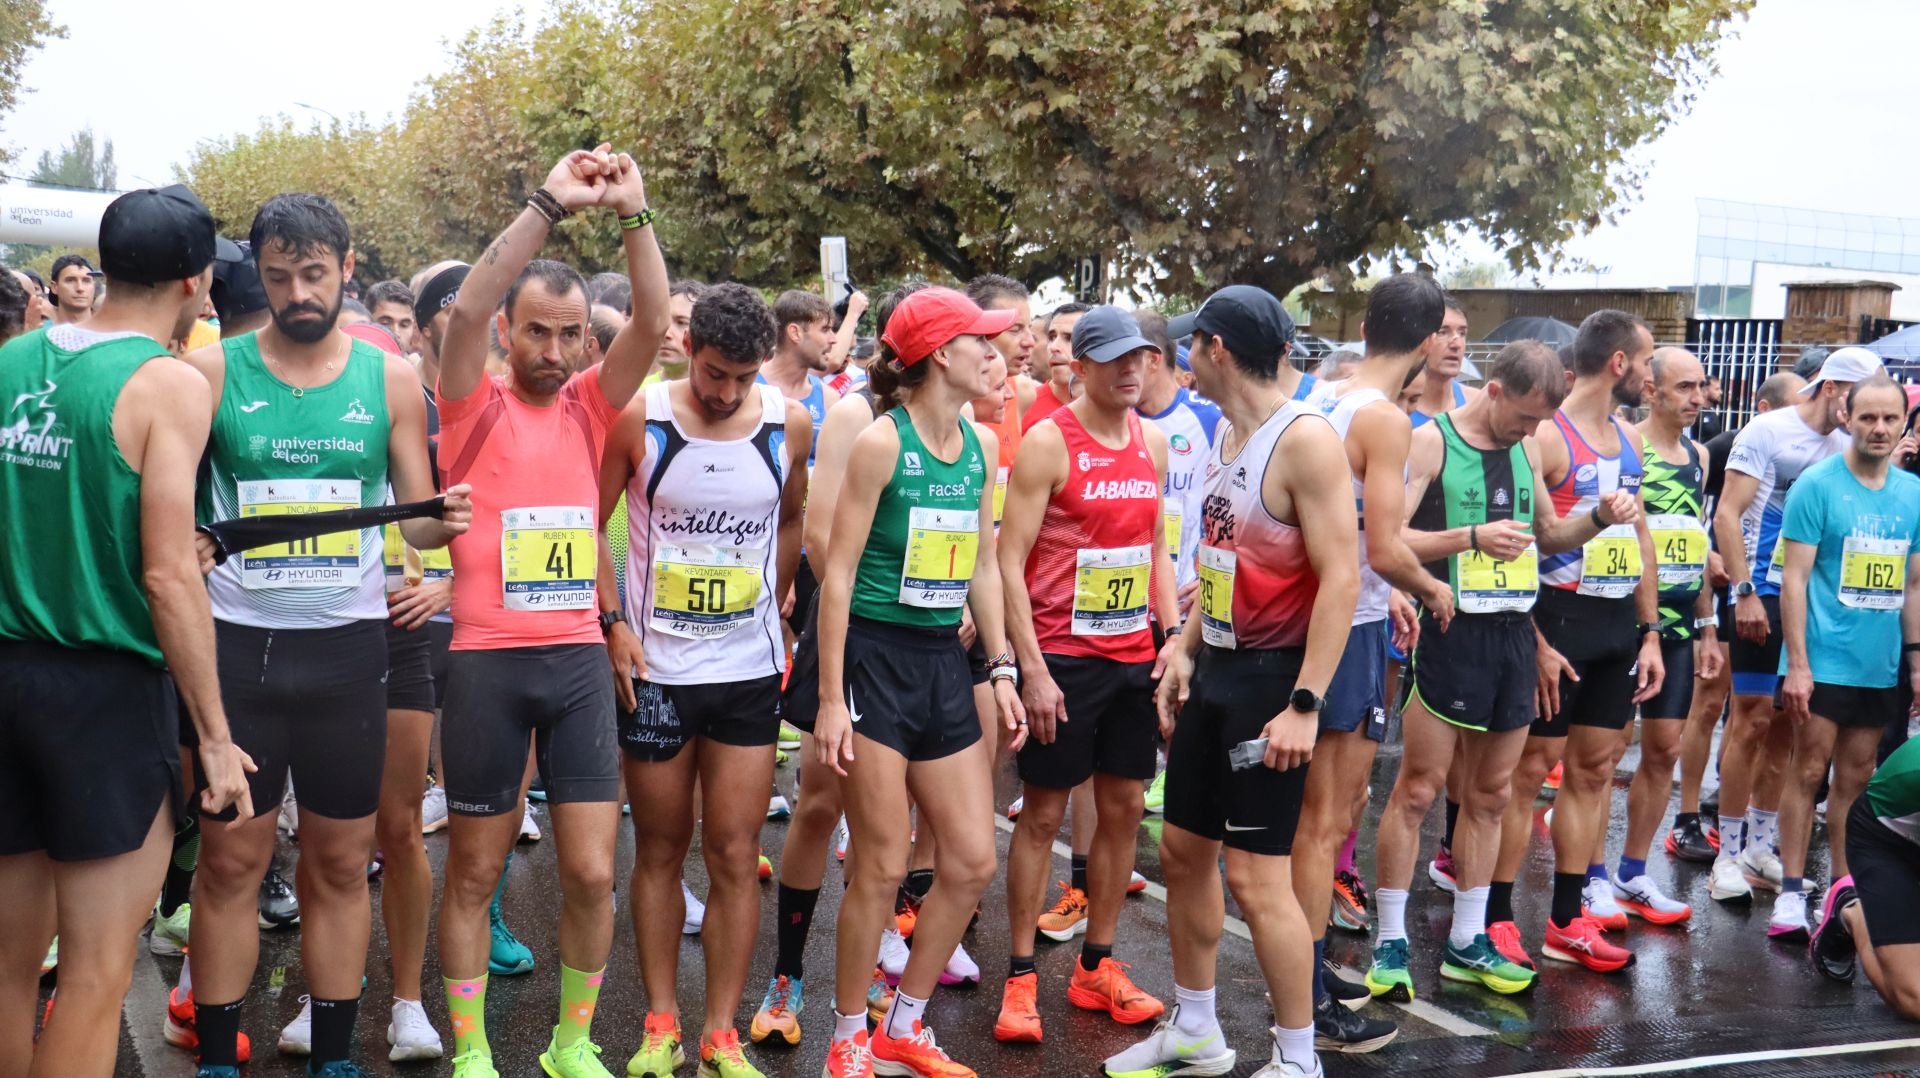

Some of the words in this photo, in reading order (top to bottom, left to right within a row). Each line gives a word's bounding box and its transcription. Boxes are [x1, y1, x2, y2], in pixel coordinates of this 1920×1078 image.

[10, 207, 73, 218] universidad
[1080, 258, 1094, 301] P
[271, 436, 365, 453] universidad
[286, 505, 320, 515] INCLÁN
[658, 506, 708, 515] TEAM
[543, 532, 568, 541] RUBEN
[545, 542, 574, 579] 41
[948, 543, 957, 579] 1
[1606, 546, 1628, 576] 34
[1664, 537, 1687, 564] 49
[288, 569, 343, 580] HYUNDAI
[1493, 559, 1507, 588] 5
[1865, 562, 1894, 589] 162
[687, 577, 727, 614] 50
[1105, 577, 1134, 611] 37
[691, 622, 740, 634] HYUNDAI
